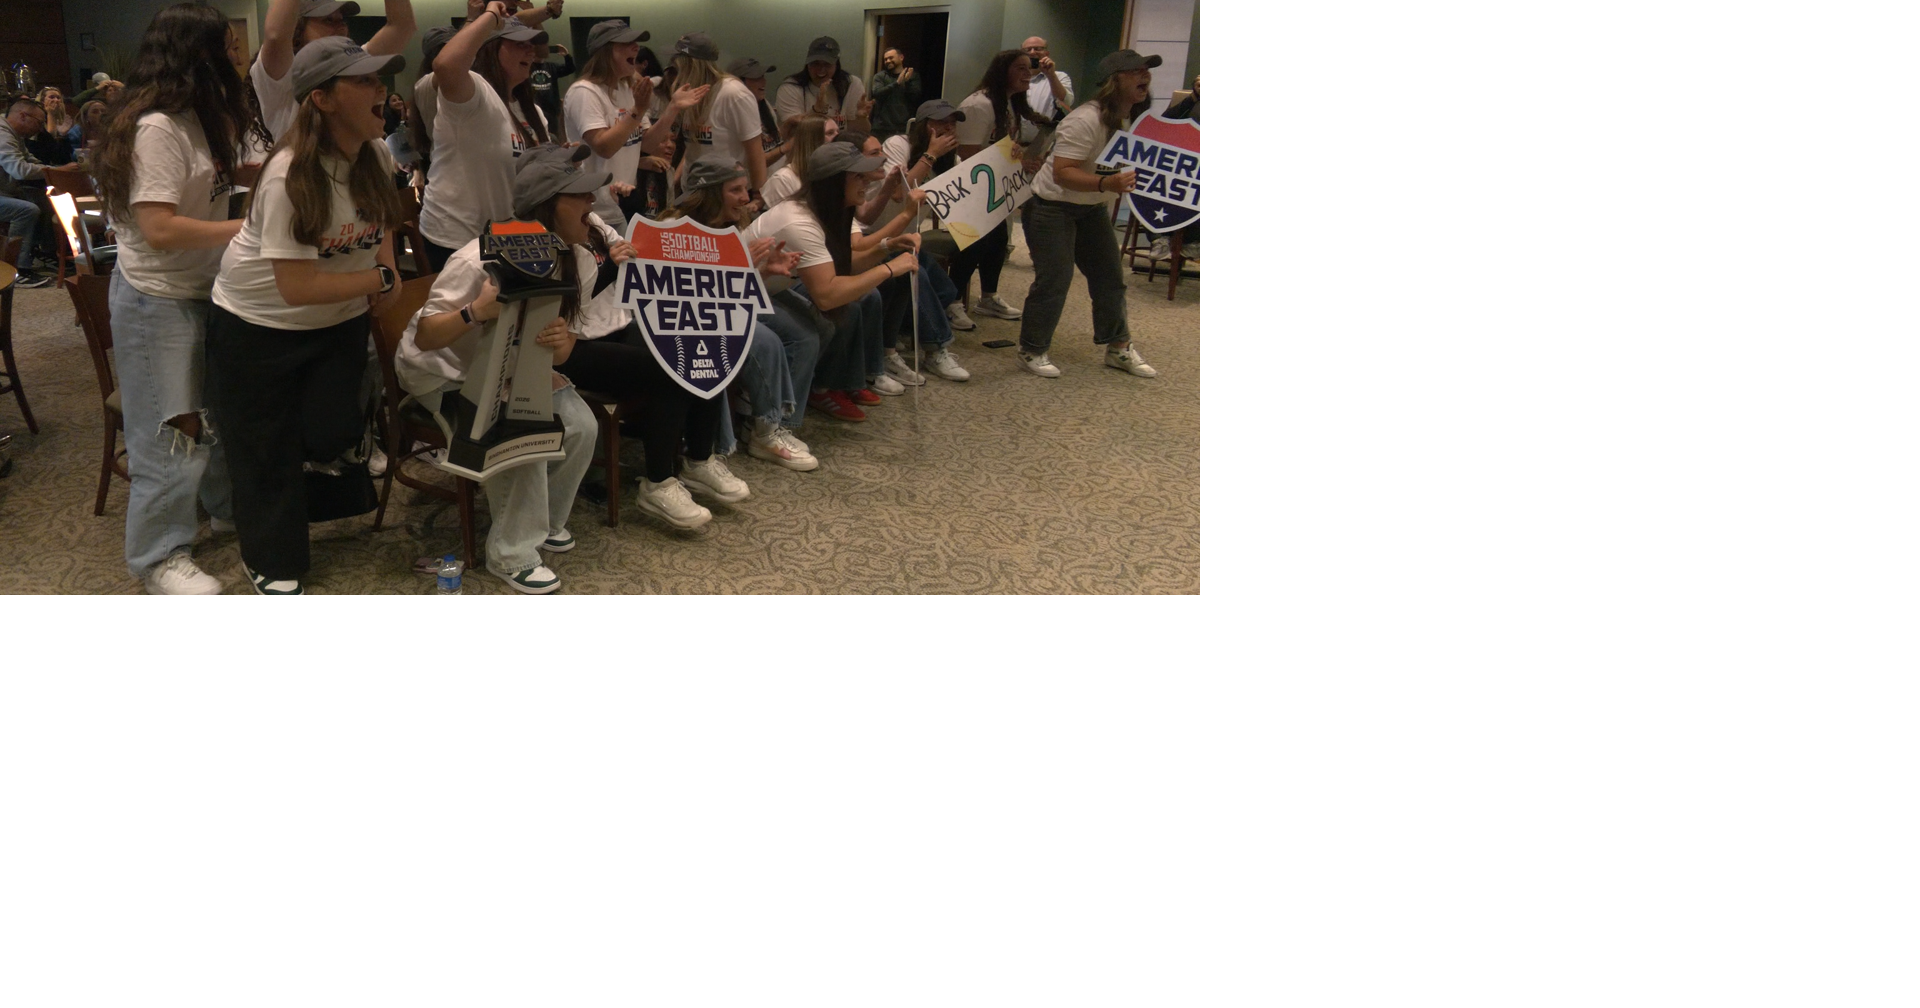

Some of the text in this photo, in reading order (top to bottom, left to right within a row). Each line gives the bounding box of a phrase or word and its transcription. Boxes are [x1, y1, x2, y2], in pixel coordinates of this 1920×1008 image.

[925, 176, 971, 219] BACK
[970, 163, 1006, 214] 2
[488, 233, 566, 252] AMERICA
[660, 231, 671, 259] 2026
[668, 232, 720, 253] SOFTBALL
[507, 247, 551, 260] EAST
[670, 248, 721, 263] CHAMPIONSHIP
[621, 262, 768, 309] AMERICA
[656, 299, 737, 332] EAST
[490, 323, 515, 422] CHAMPIONS
[692, 359, 715, 369] DELTA
[690, 369, 719, 379] DENTAL
[512, 408, 541, 416] SOFTBALL
[520, 439, 556, 449] UNIVERSITY
